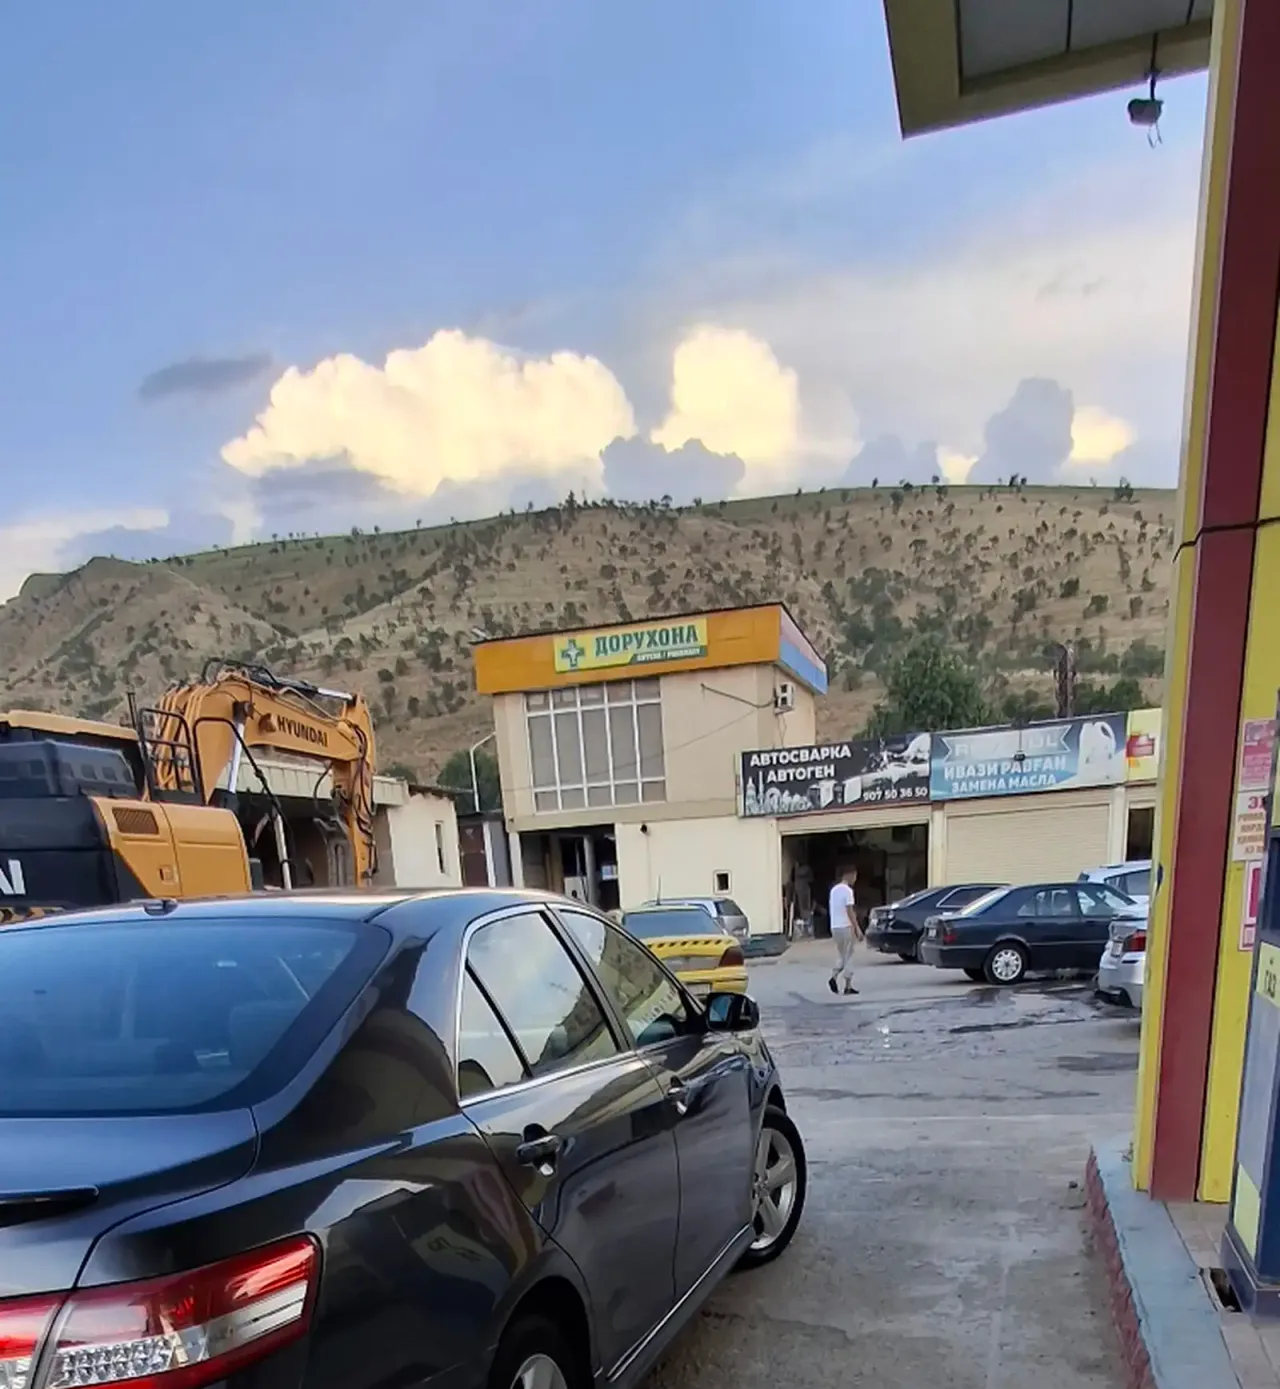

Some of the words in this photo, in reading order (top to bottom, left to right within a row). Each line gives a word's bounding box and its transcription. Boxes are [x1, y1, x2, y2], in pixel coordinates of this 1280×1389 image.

[595, 624, 698, 657] ДОРУХОНА
[277, 715, 328, 748] HYUNDAI
[750, 744, 851, 767] АВТОСВАРКА
[767, 764, 835, 783] АВТОГЕН
[944, 761, 998, 780] ИВАЗИ
[952, 778, 1007, 795] ЗАМЕНА
[1008, 774, 1056, 792] МАСЛА
